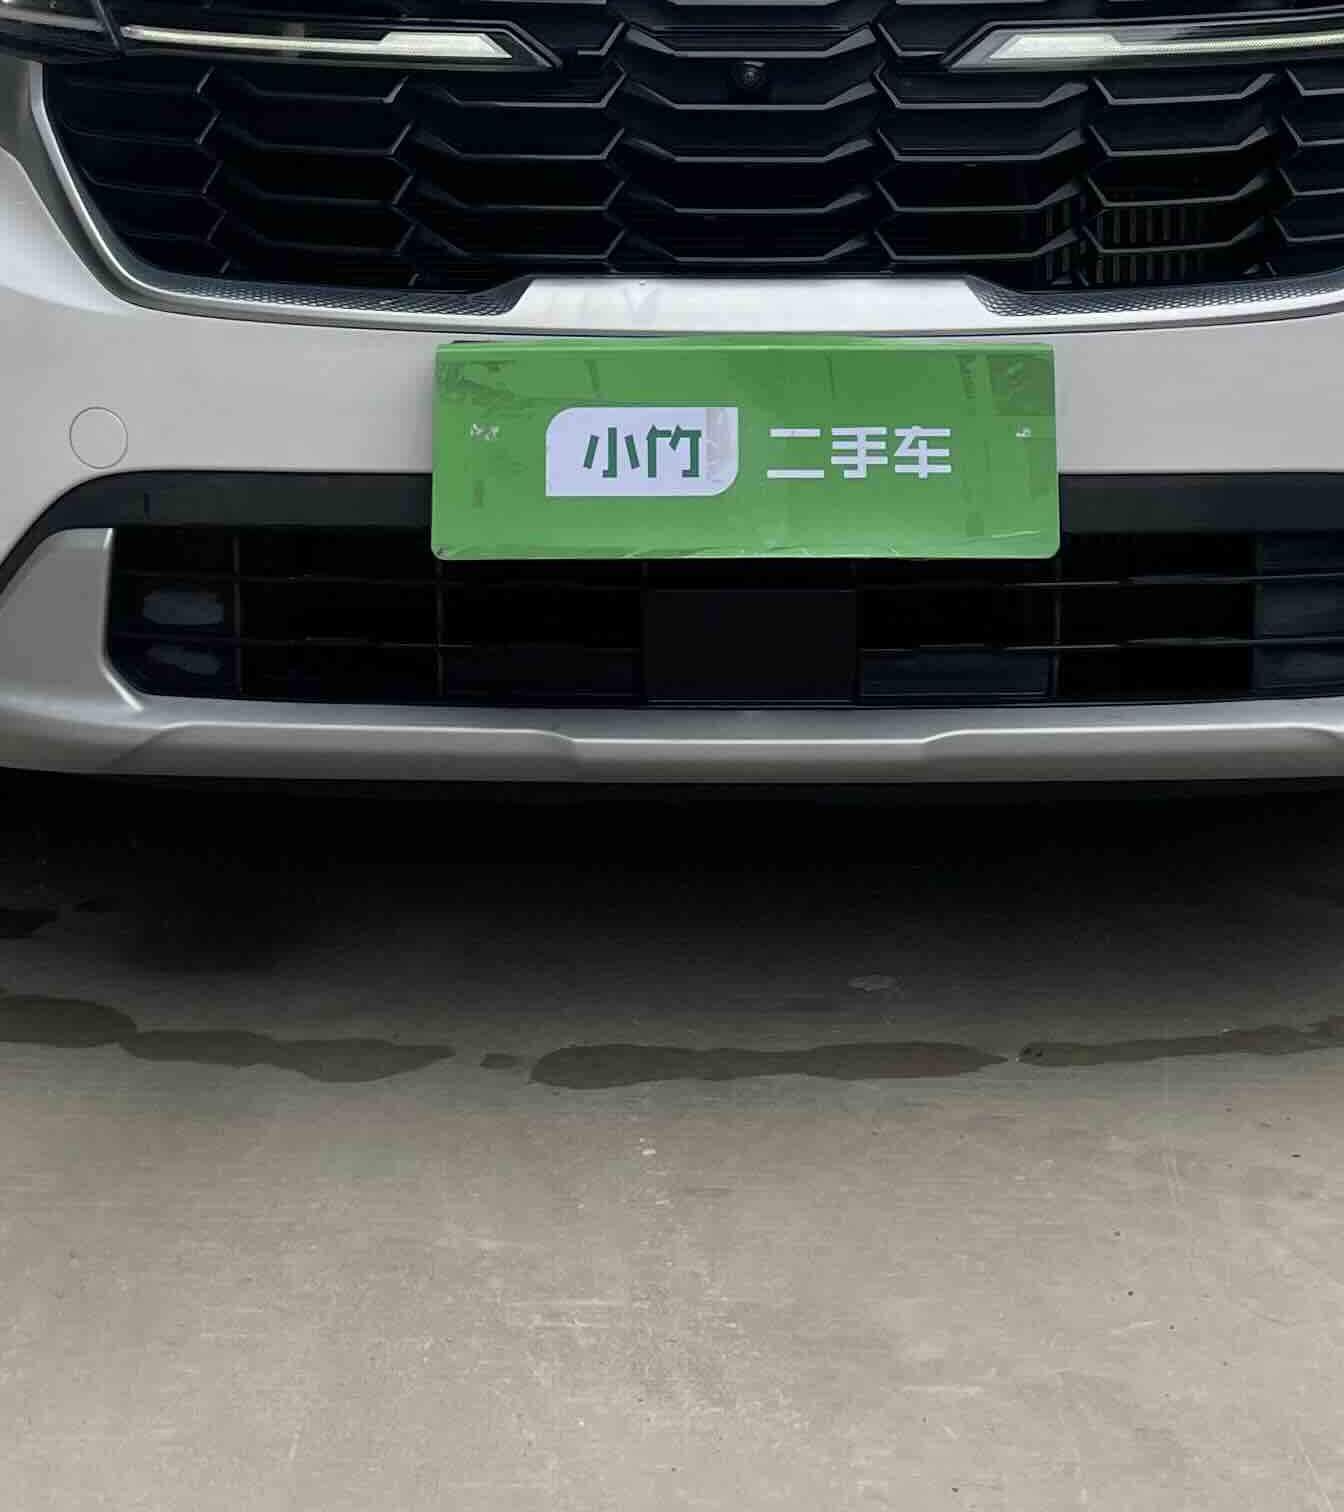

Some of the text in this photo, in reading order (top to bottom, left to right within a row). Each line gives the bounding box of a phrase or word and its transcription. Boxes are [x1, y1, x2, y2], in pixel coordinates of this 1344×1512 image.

[583, 424, 953, 480] 小竹 二手车
